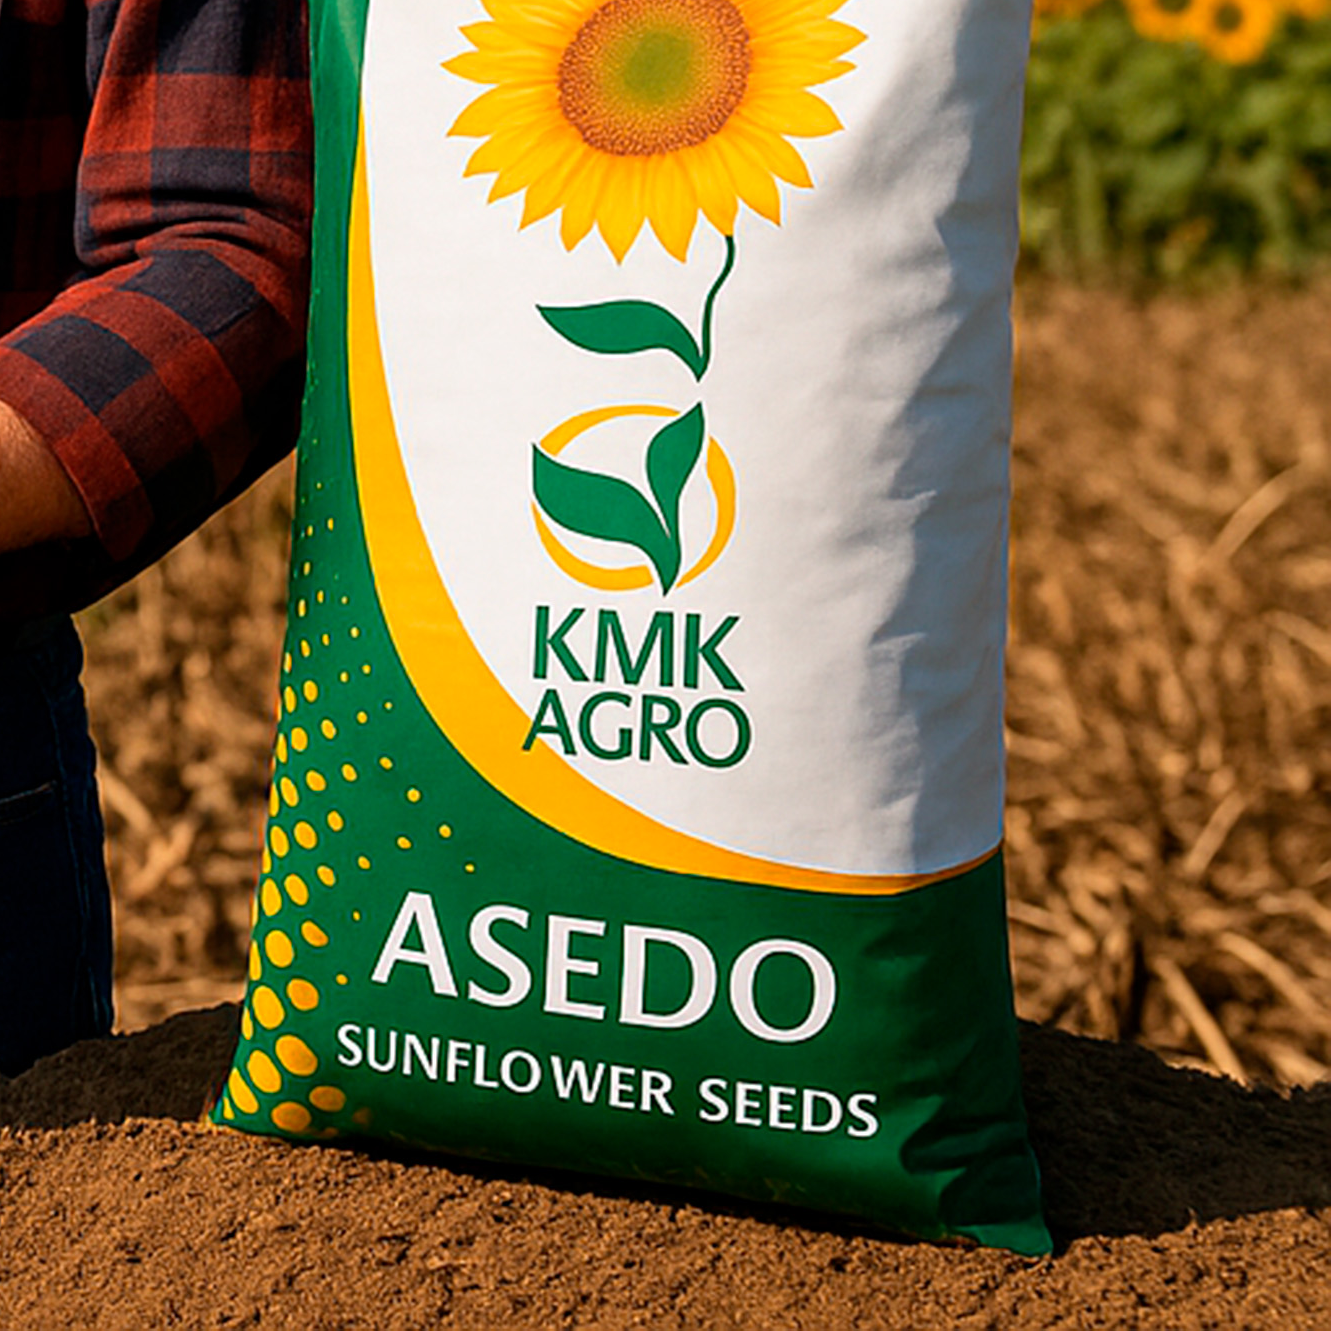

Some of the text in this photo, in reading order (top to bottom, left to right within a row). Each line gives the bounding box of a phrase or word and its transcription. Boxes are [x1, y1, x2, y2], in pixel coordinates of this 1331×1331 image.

[531, 605, 747, 692] KMK
[521, 687, 753, 769] AGRO
[371, 890, 837, 1043] ASEDO
[336, 1022, 880, 1139] SUNFLOWER SEEDS
